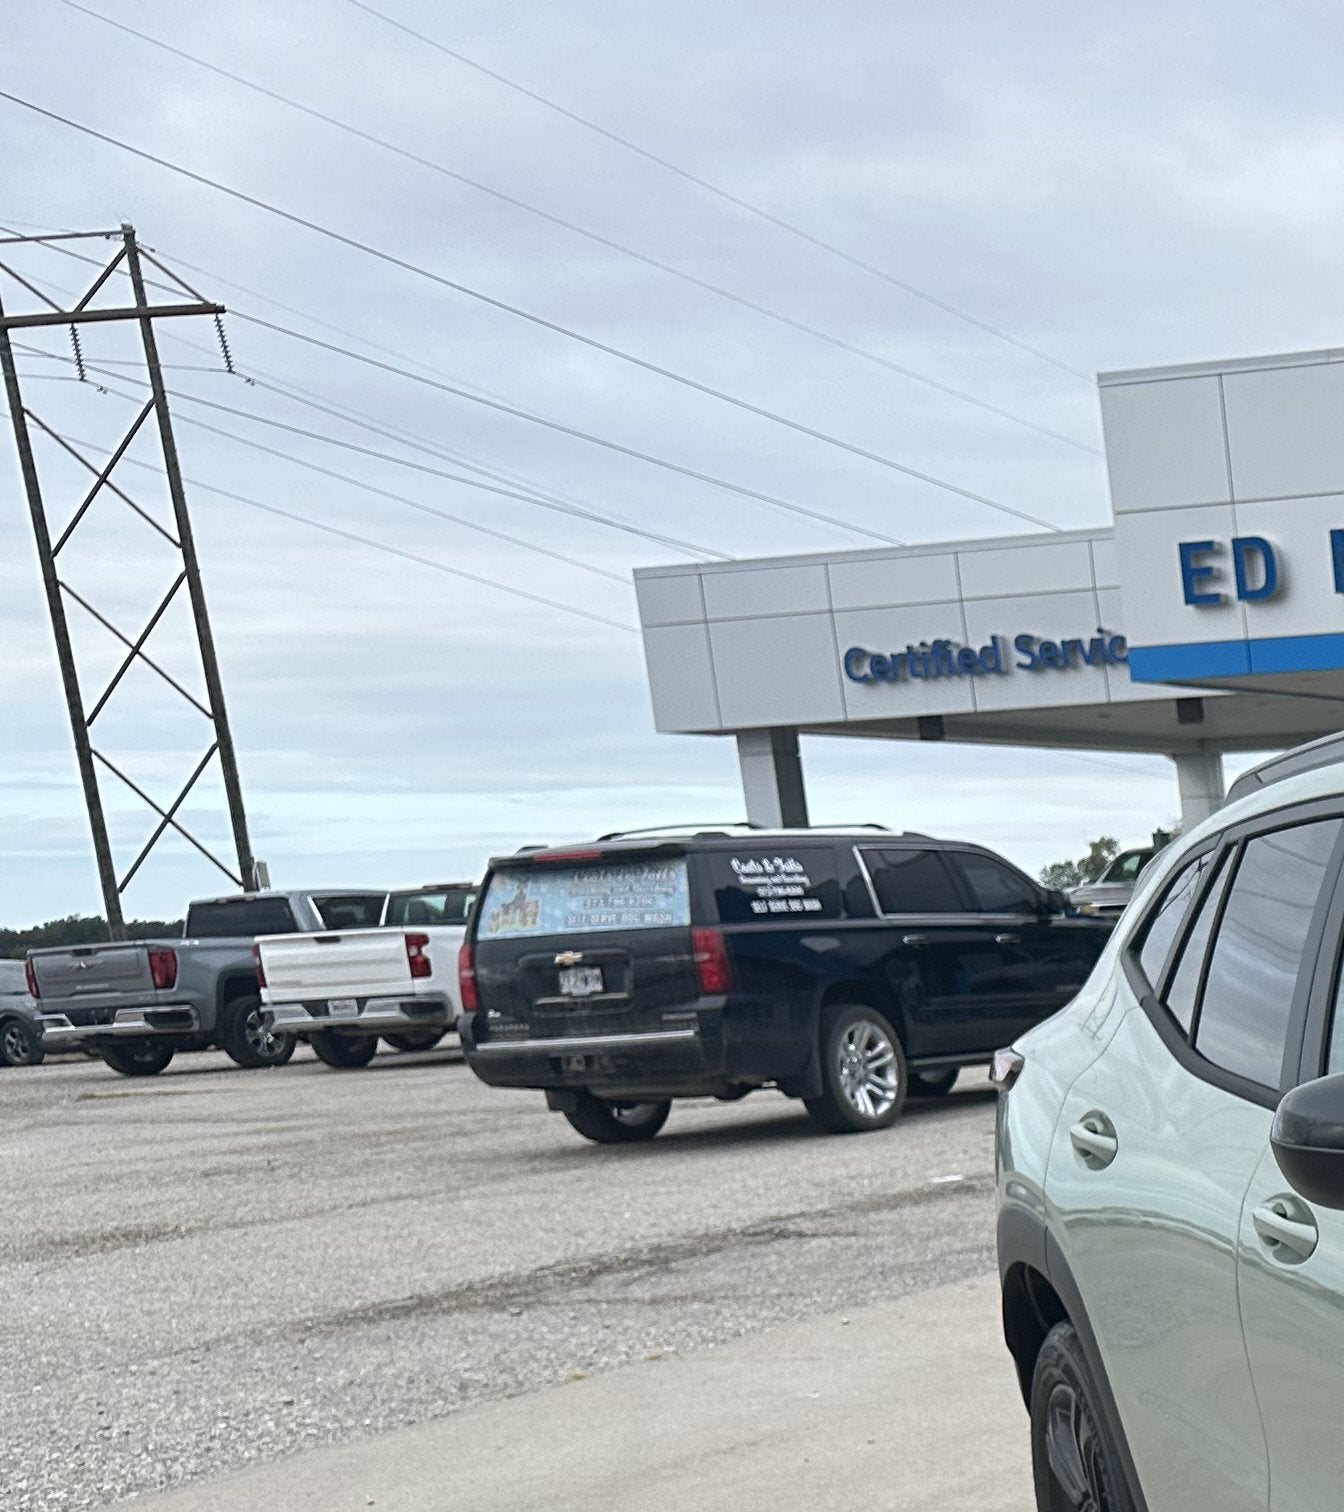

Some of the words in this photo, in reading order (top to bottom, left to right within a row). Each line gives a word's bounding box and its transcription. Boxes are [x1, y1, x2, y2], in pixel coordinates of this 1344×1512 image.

[1179, 536, 1280, 606] ED
[844, 634, 1002, 683] Certified
[1014, 634, 1128, 671] Servic
